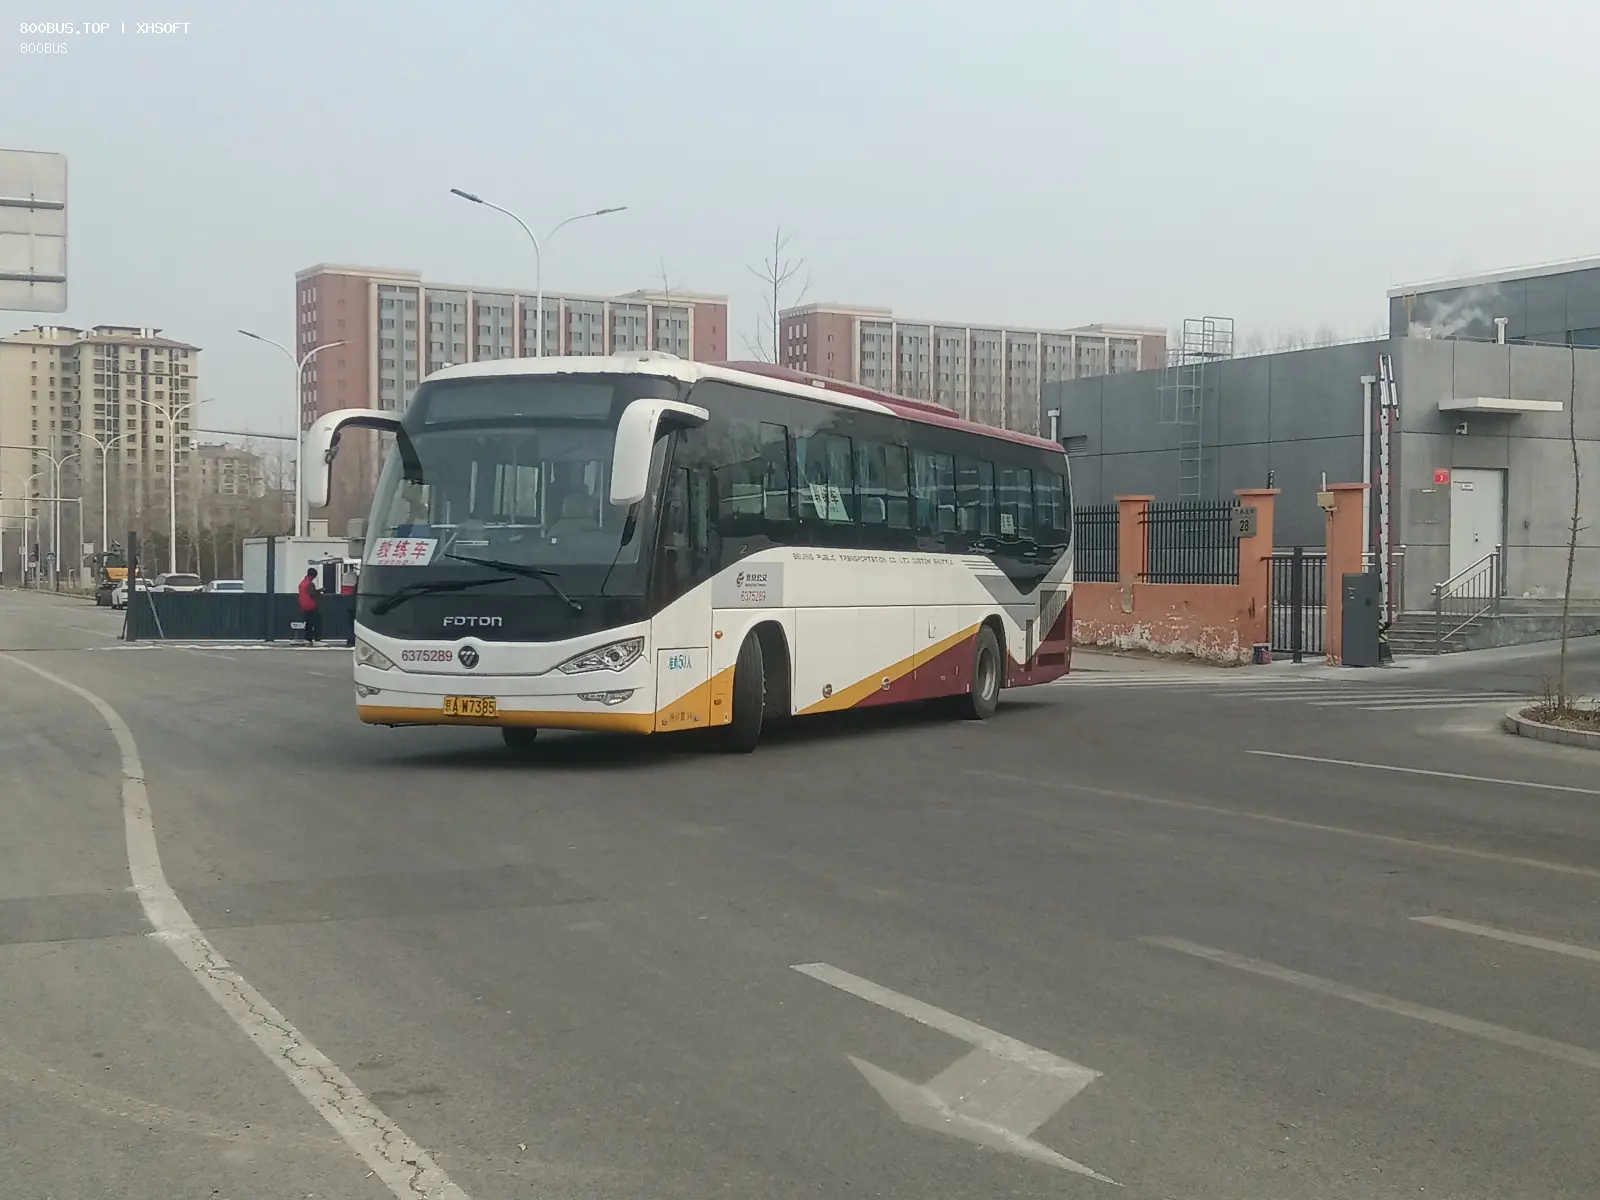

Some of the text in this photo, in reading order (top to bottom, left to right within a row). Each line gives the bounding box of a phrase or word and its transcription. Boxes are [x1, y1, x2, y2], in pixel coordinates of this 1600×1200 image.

[1239, 519, 1250, 532] 28
[376, 540, 429, 560] 教练车
[740, 590, 766, 602] 6375289
[443, 616, 503, 627] FOTON
[401, 650, 453, 662] 6375289
